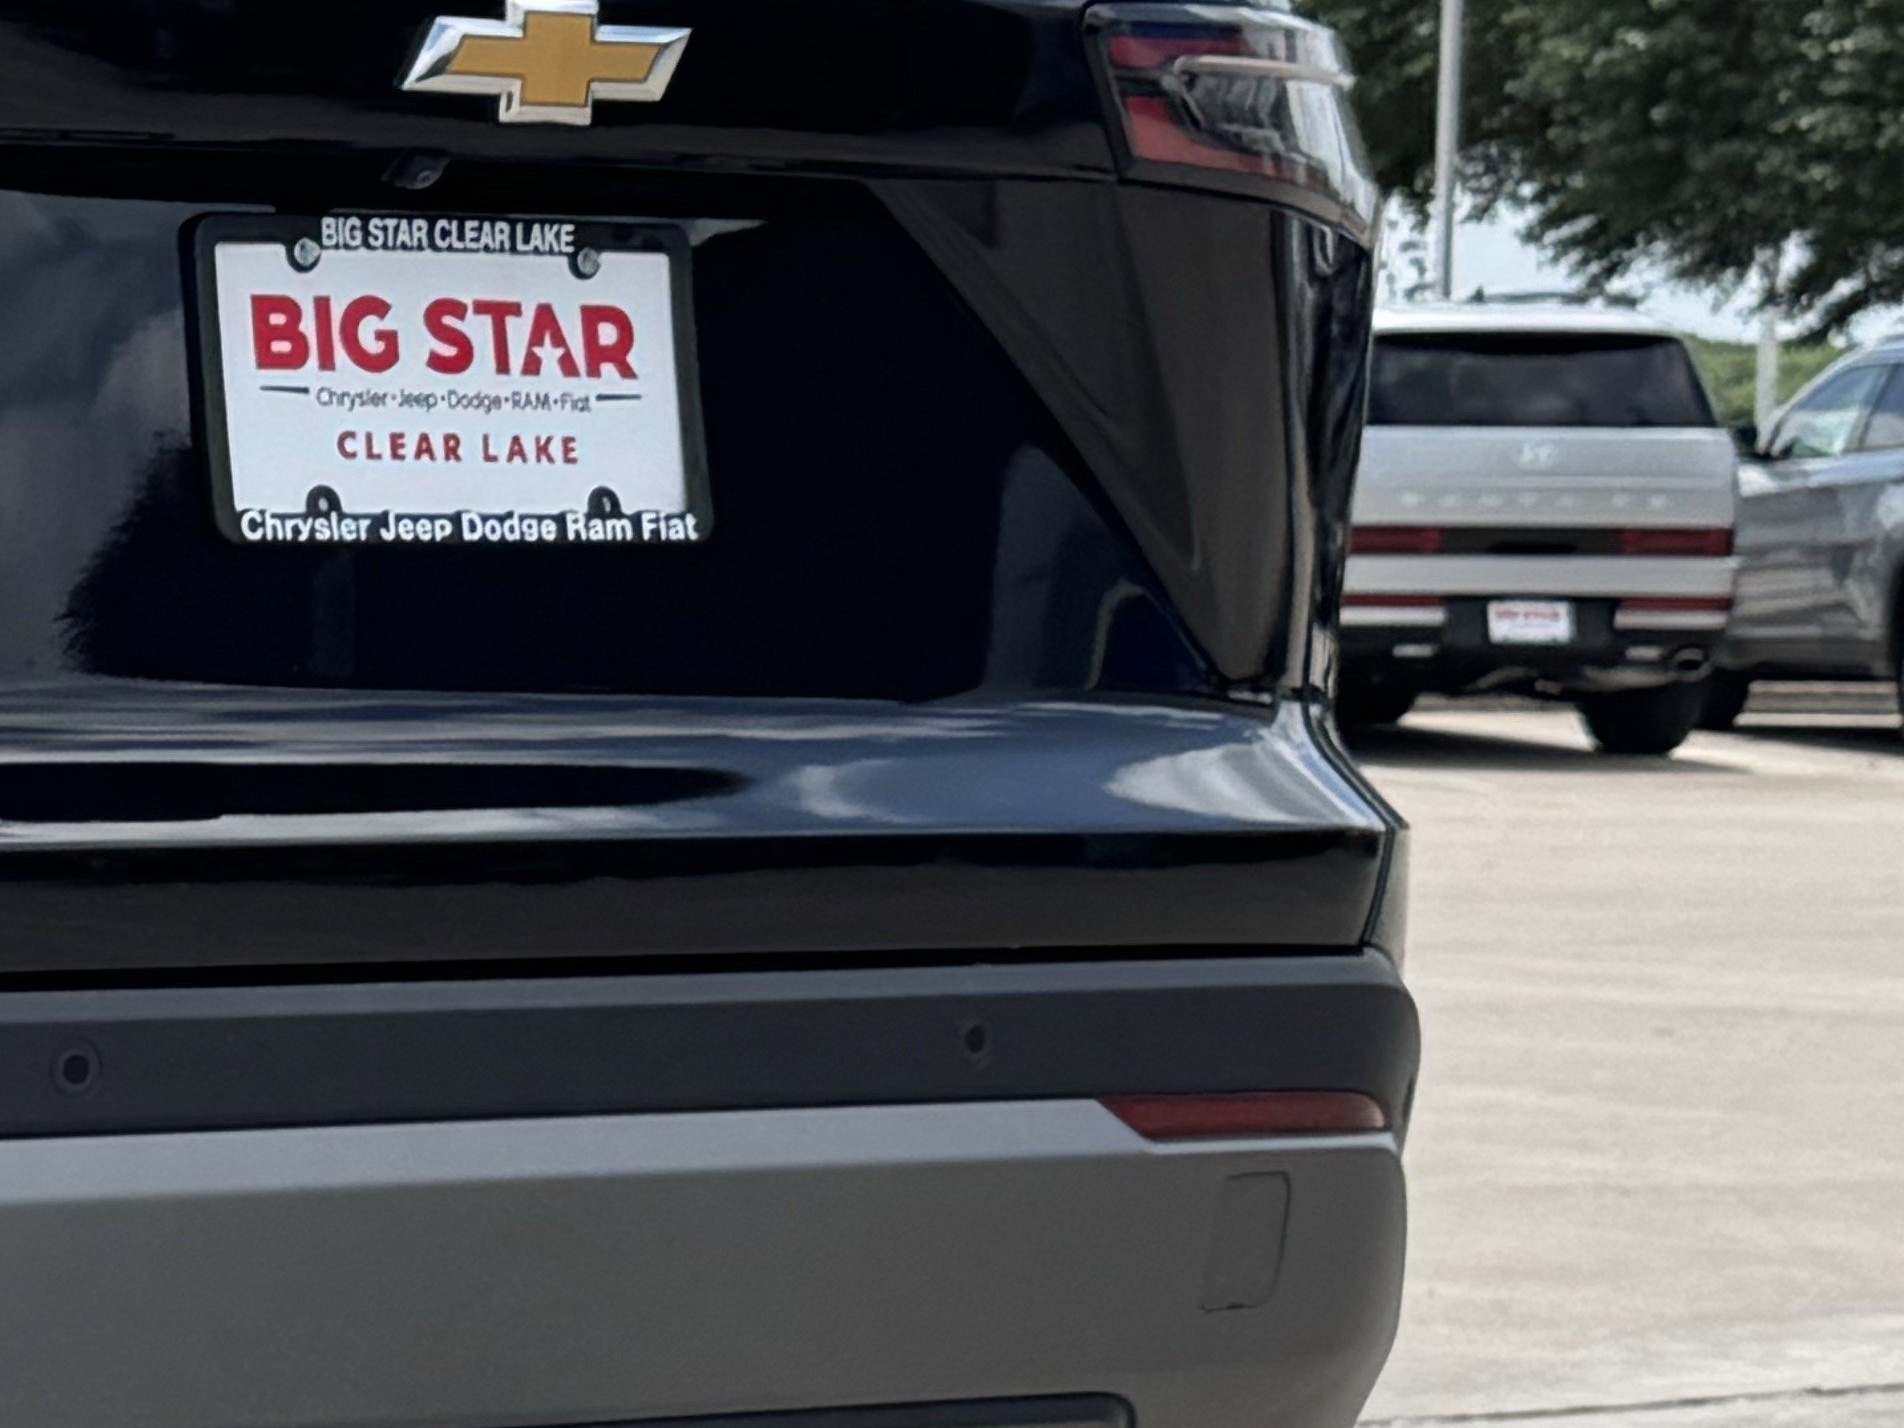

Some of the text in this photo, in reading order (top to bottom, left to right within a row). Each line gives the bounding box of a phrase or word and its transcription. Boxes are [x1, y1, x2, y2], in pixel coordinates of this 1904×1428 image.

[321, 216, 576, 254] BIG STAR CLEAR LAKE
[249, 293, 639, 380] BIG STAR
[315, 386, 591, 414] Chrysler Jeep Dodge RAM Fiat
[336, 430, 579, 465] CLEAR LAKE
[240, 510, 699, 543] Chrysler Jeep Dodge Ram Fiat
